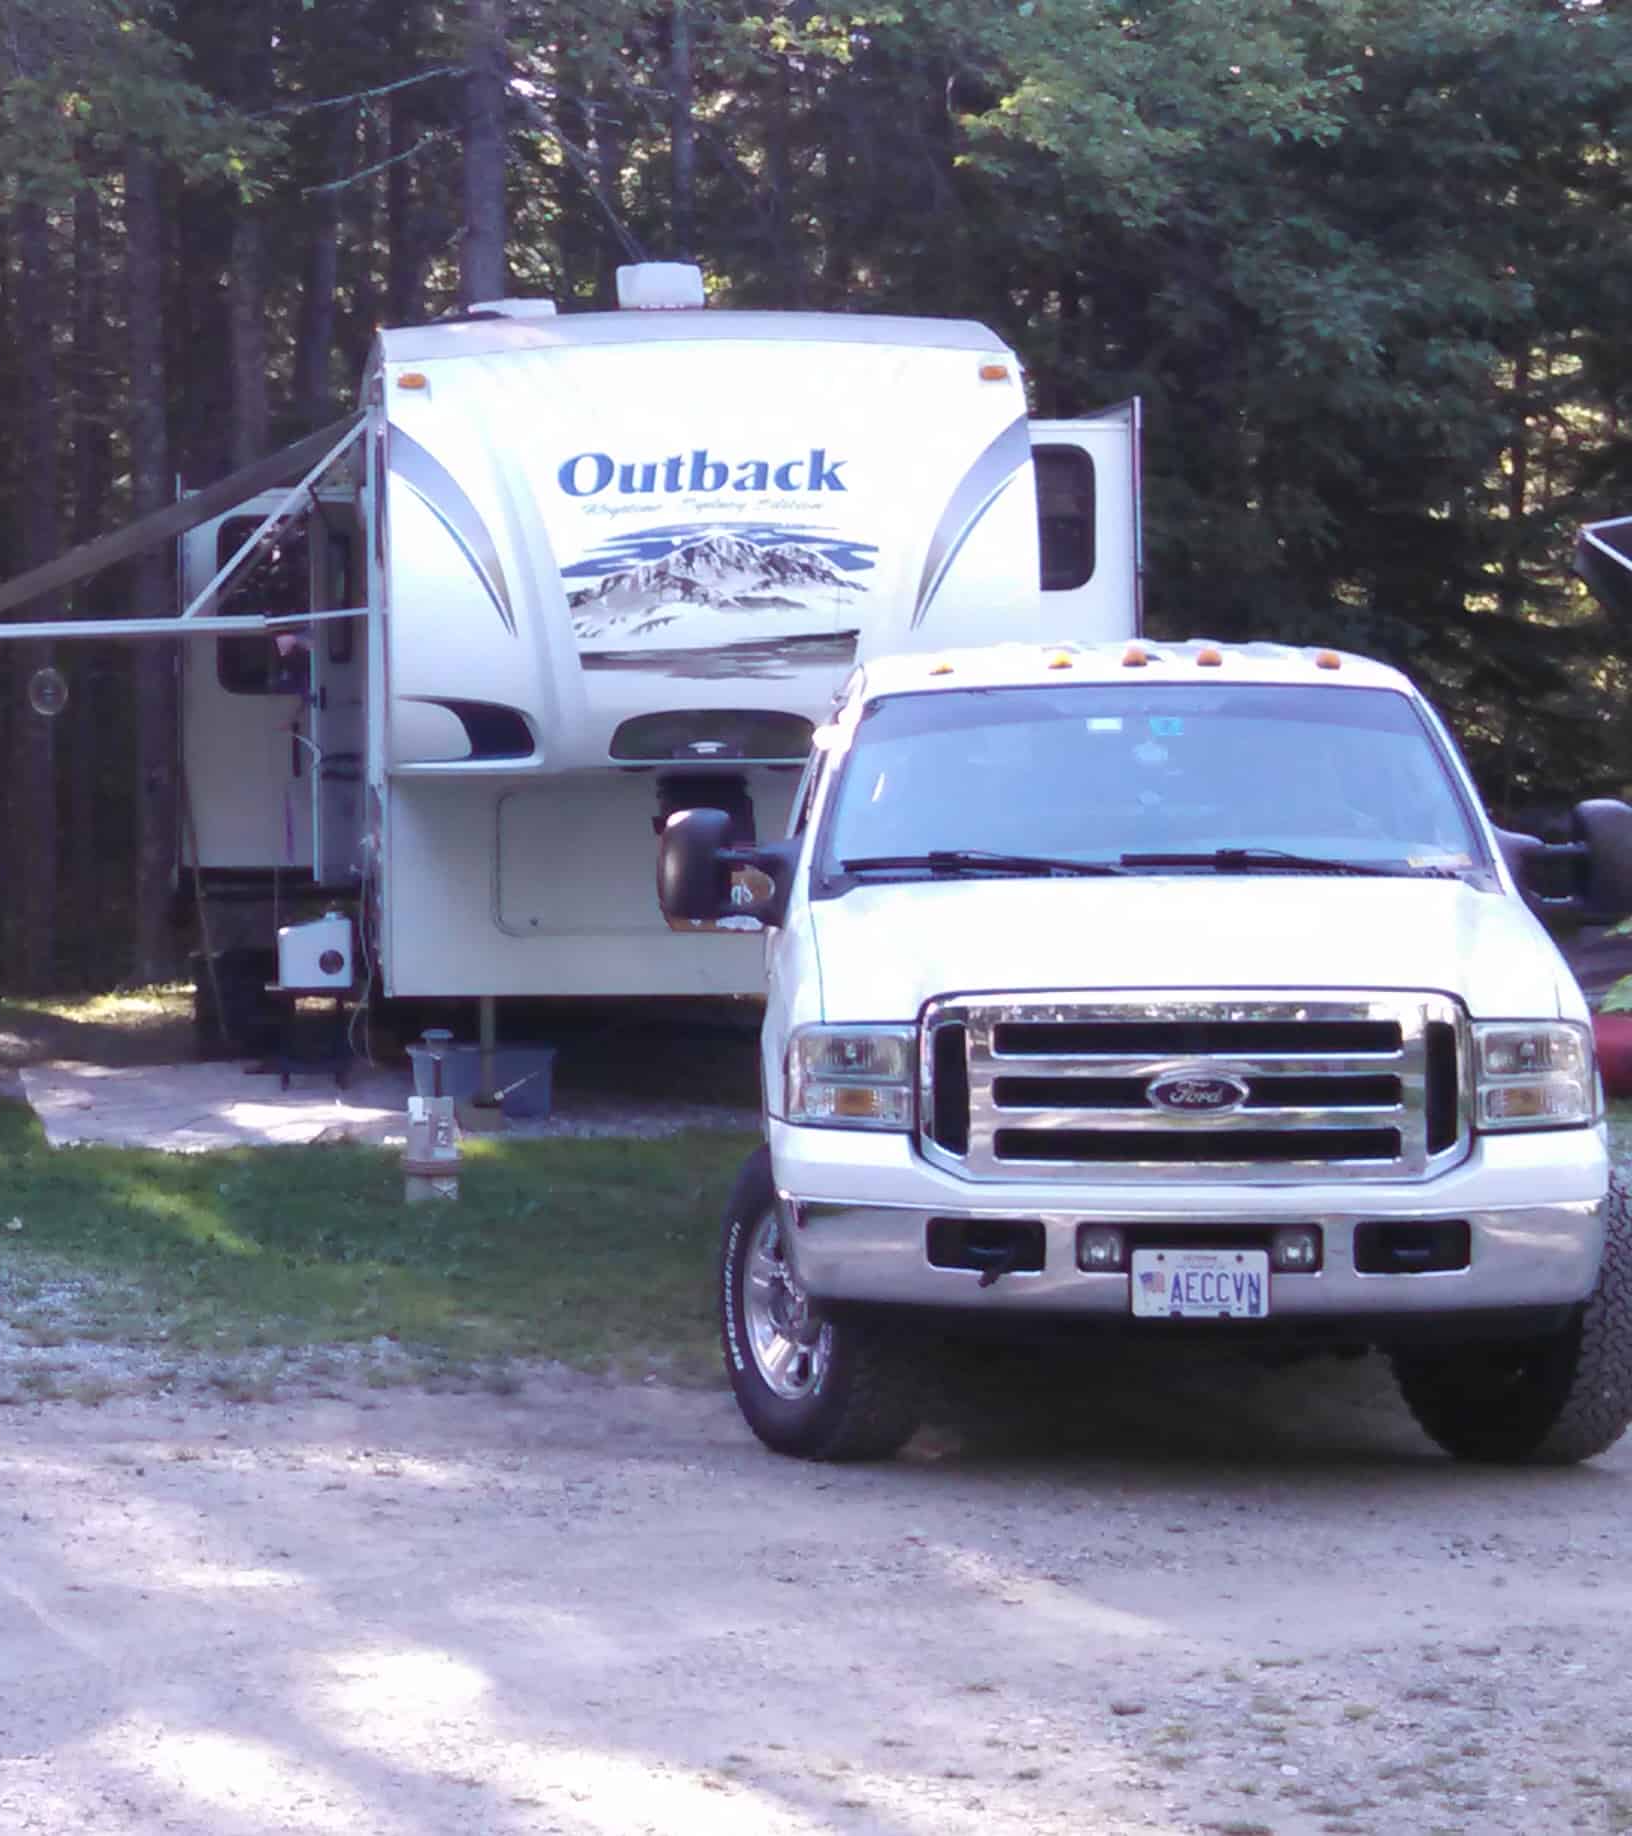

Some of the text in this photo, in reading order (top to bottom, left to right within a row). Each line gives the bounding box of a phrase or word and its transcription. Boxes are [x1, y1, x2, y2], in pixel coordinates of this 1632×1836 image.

[557, 448, 849, 497] Outback
[1169, 1079, 1223, 1103] Ford
[1170, 1271, 1262, 1304] AECCVN
